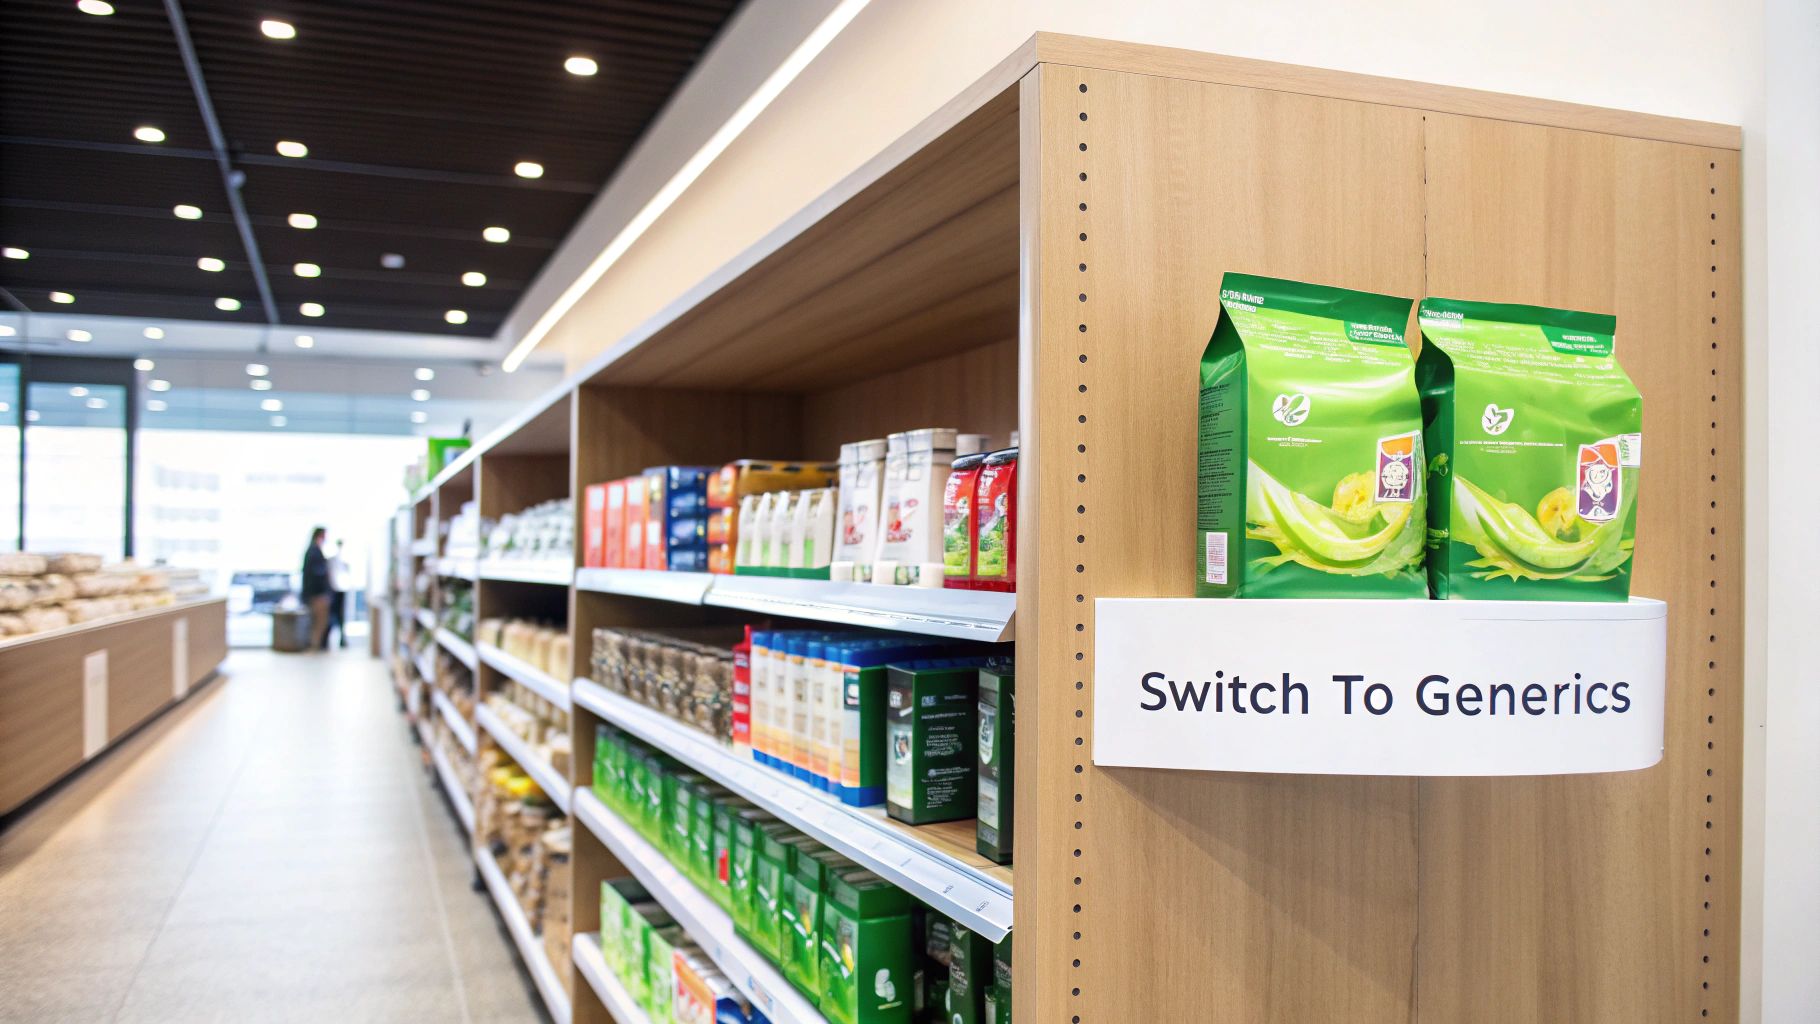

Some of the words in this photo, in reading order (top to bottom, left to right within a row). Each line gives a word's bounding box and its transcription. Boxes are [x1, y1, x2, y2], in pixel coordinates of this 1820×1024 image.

[1140, 670, 1309, 716] Switch
[1332, 674, 1394, 716] To
[1415, 672, 1631, 717] Generics
